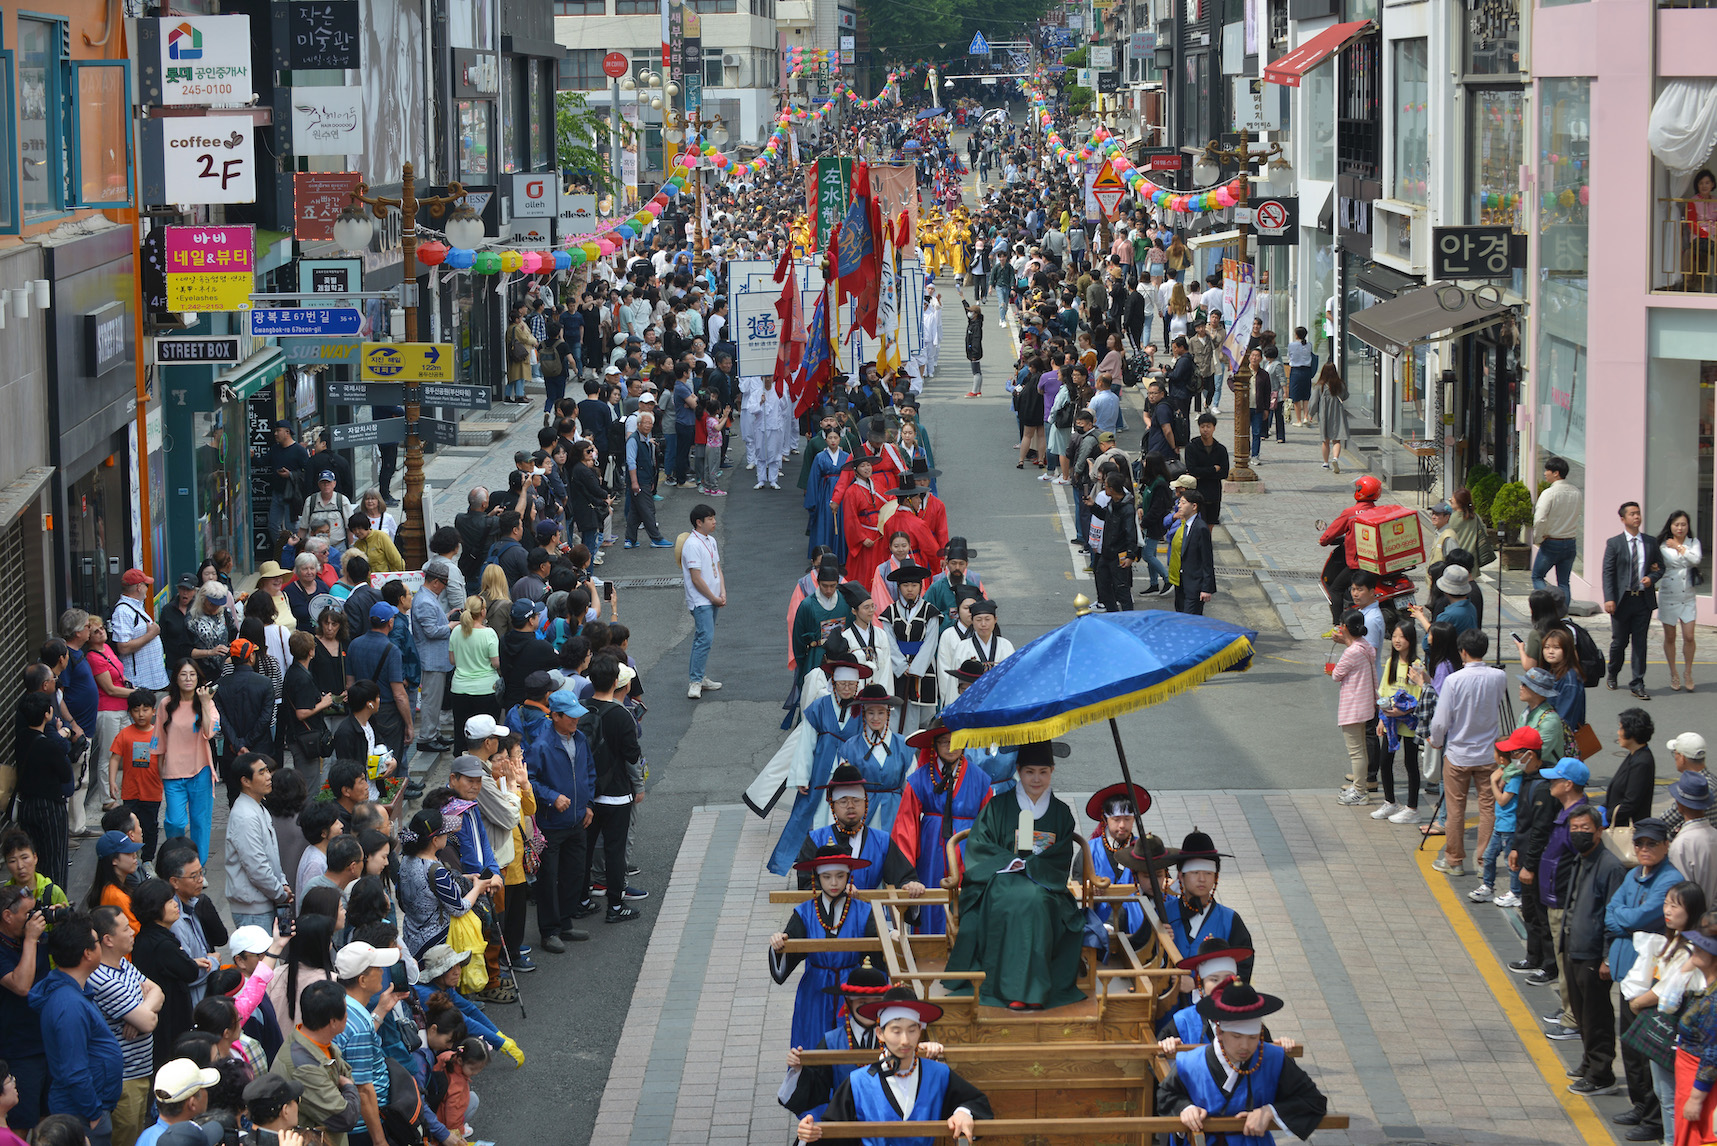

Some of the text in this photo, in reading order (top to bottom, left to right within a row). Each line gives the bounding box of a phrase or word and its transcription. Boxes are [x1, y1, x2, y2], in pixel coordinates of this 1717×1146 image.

[299, 6, 334, 26] 작은
[297, 26, 354, 52] 미술관
[670, 12, 683, 80] 새부산타운
[166, 66, 248, 84] 롯데 공인중개사
[182, 84, 232, 95] 245-0100
[1253, 94, 1263, 120] 베이지
[169, 137, 221, 148] coffee
[196, 154, 243, 190] 2F
[310, 195, 340, 209] 새빨간
[560, 210, 592, 219] ellesse
[193, 231, 227, 245] 바비
[173, 249, 248, 267] 네일&뷰티
[1439, 233, 1509, 273] 안경
[150, 298, 166, 307] 4F
[180, 294, 218, 302] Eyelashes
[253, 325, 322, 334] Gwangbok-ro 67beon-gil
[162, 342, 231, 359] STREET BOX
[287, 344, 359, 360] SUBWAY
[343, 384, 367, 392] 국제시장
[347, 424, 378, 434] 자갈치시장
[1385, 538, 1418, 553] 1600-9999
